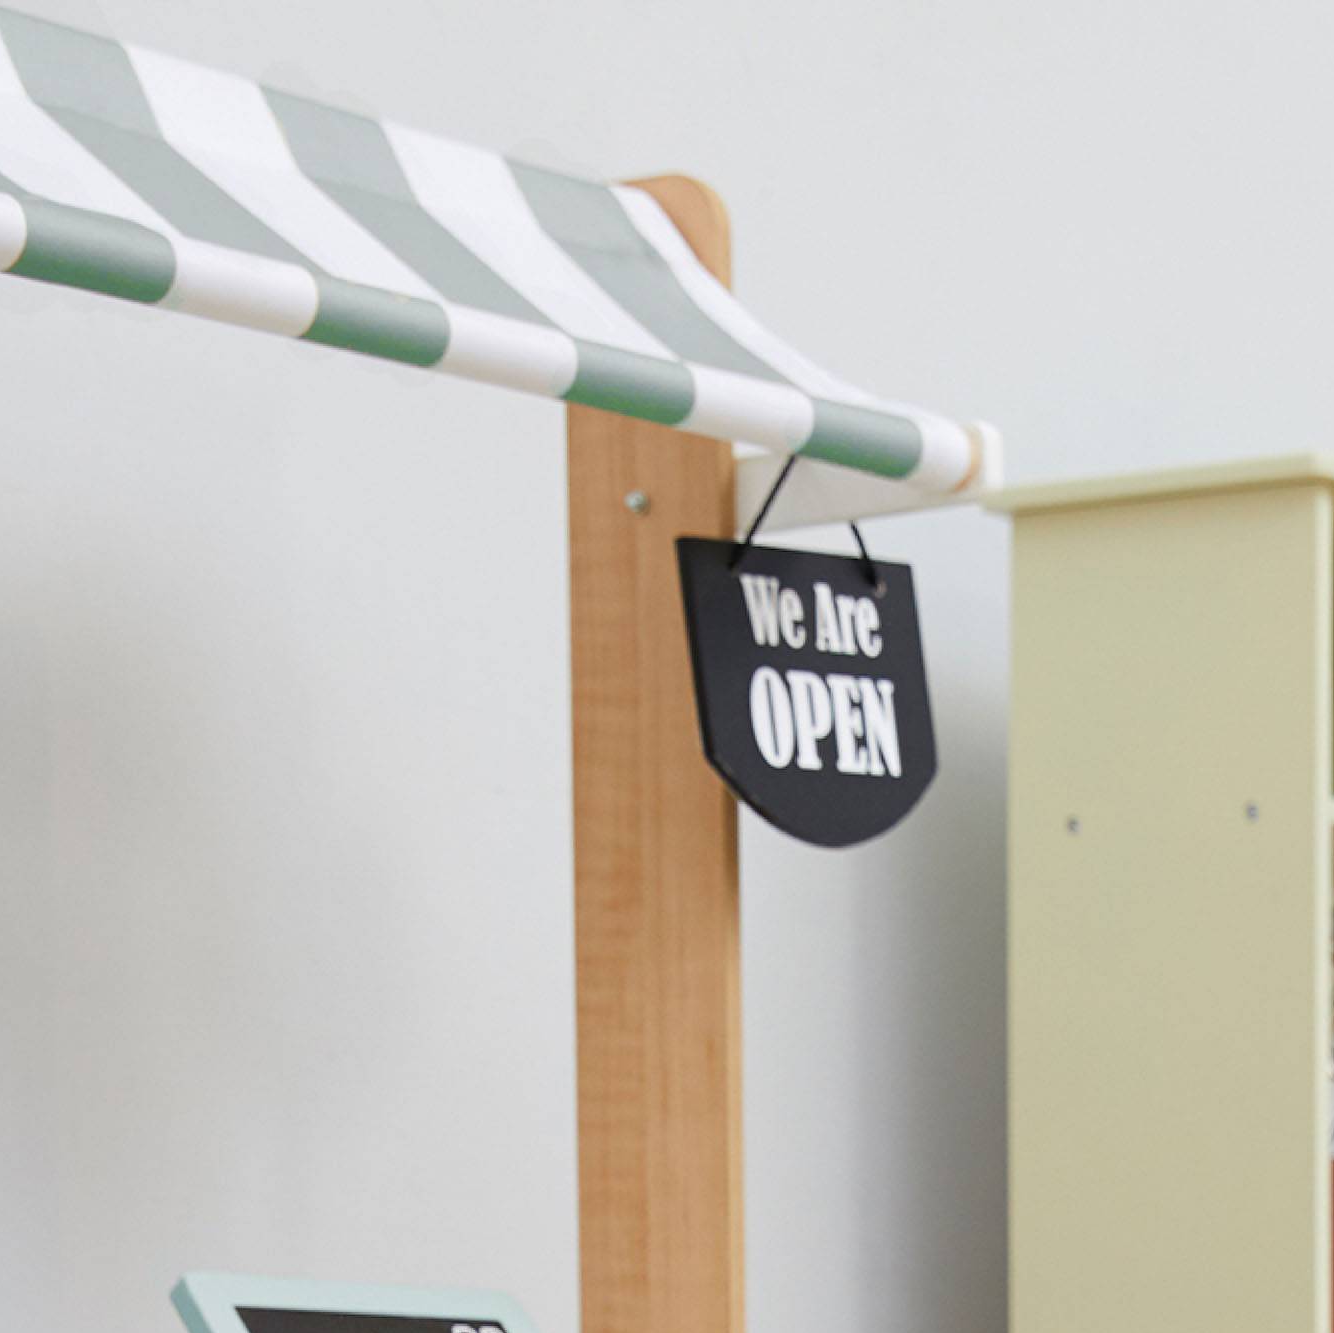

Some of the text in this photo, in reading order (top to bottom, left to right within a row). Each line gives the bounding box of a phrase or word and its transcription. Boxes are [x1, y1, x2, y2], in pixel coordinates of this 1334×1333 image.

[739, 573, 884, 659] We Are
[749, 665, 903, 778] OPEN
